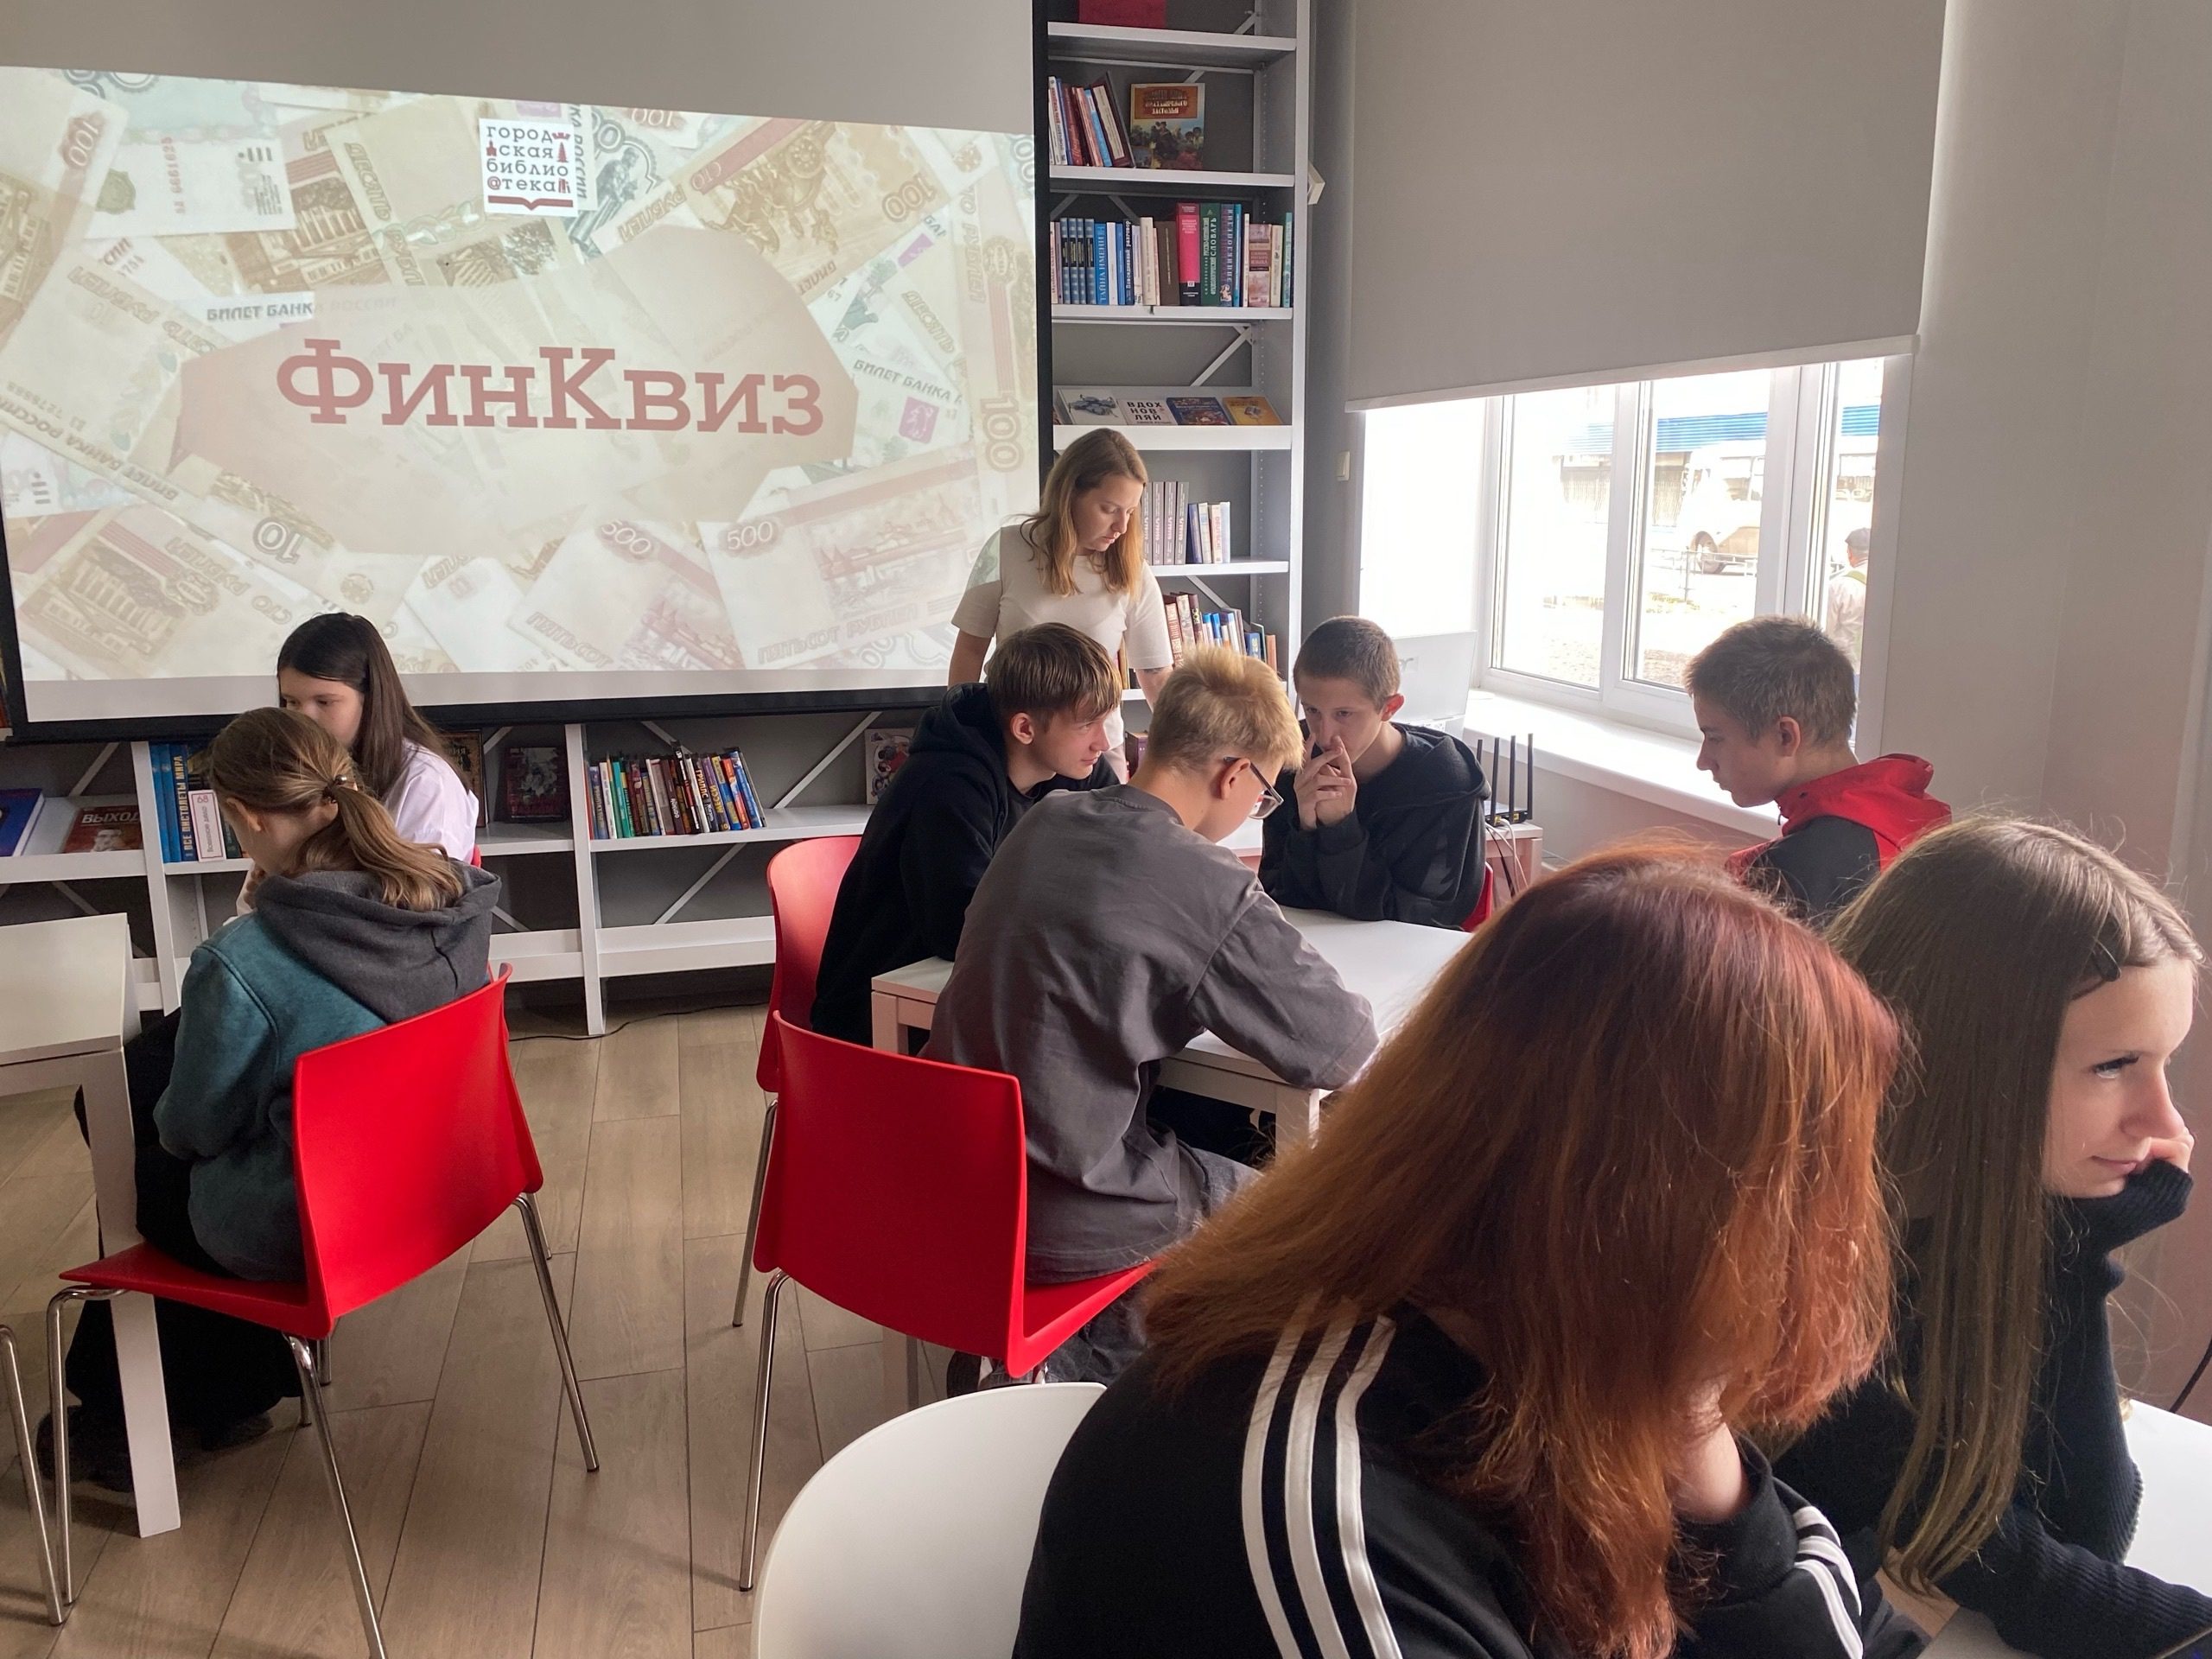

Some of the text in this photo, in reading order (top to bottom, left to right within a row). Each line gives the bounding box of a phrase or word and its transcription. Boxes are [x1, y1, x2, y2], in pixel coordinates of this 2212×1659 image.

[68, 120, 99, 167] 100
[486, 126, 553, 144] город
[499, 144, 554, 159] ская
[486, 157, 569, 177] библио
[881, 172, 937, 224] 100
[207, 304, 264, 322] БИЛЕТ
[853, 359, 903, 384] БИЛЕТ
[902, 377, 951, 400] БАНКА
[253, 518, 308, 566] 10
[727, 520, 773, 550] 500
[174, 755, 185, 780] МИРА
[695, 768, 709, 798] ГРИЛЛС
[176, 781, 191, 832] ПИСТОЛЕТЫ
[197, 795, 208, 804] 68
[709, 784, 724, 813] МЕССИ
[182, 834, 193, 851] ВСЕ
